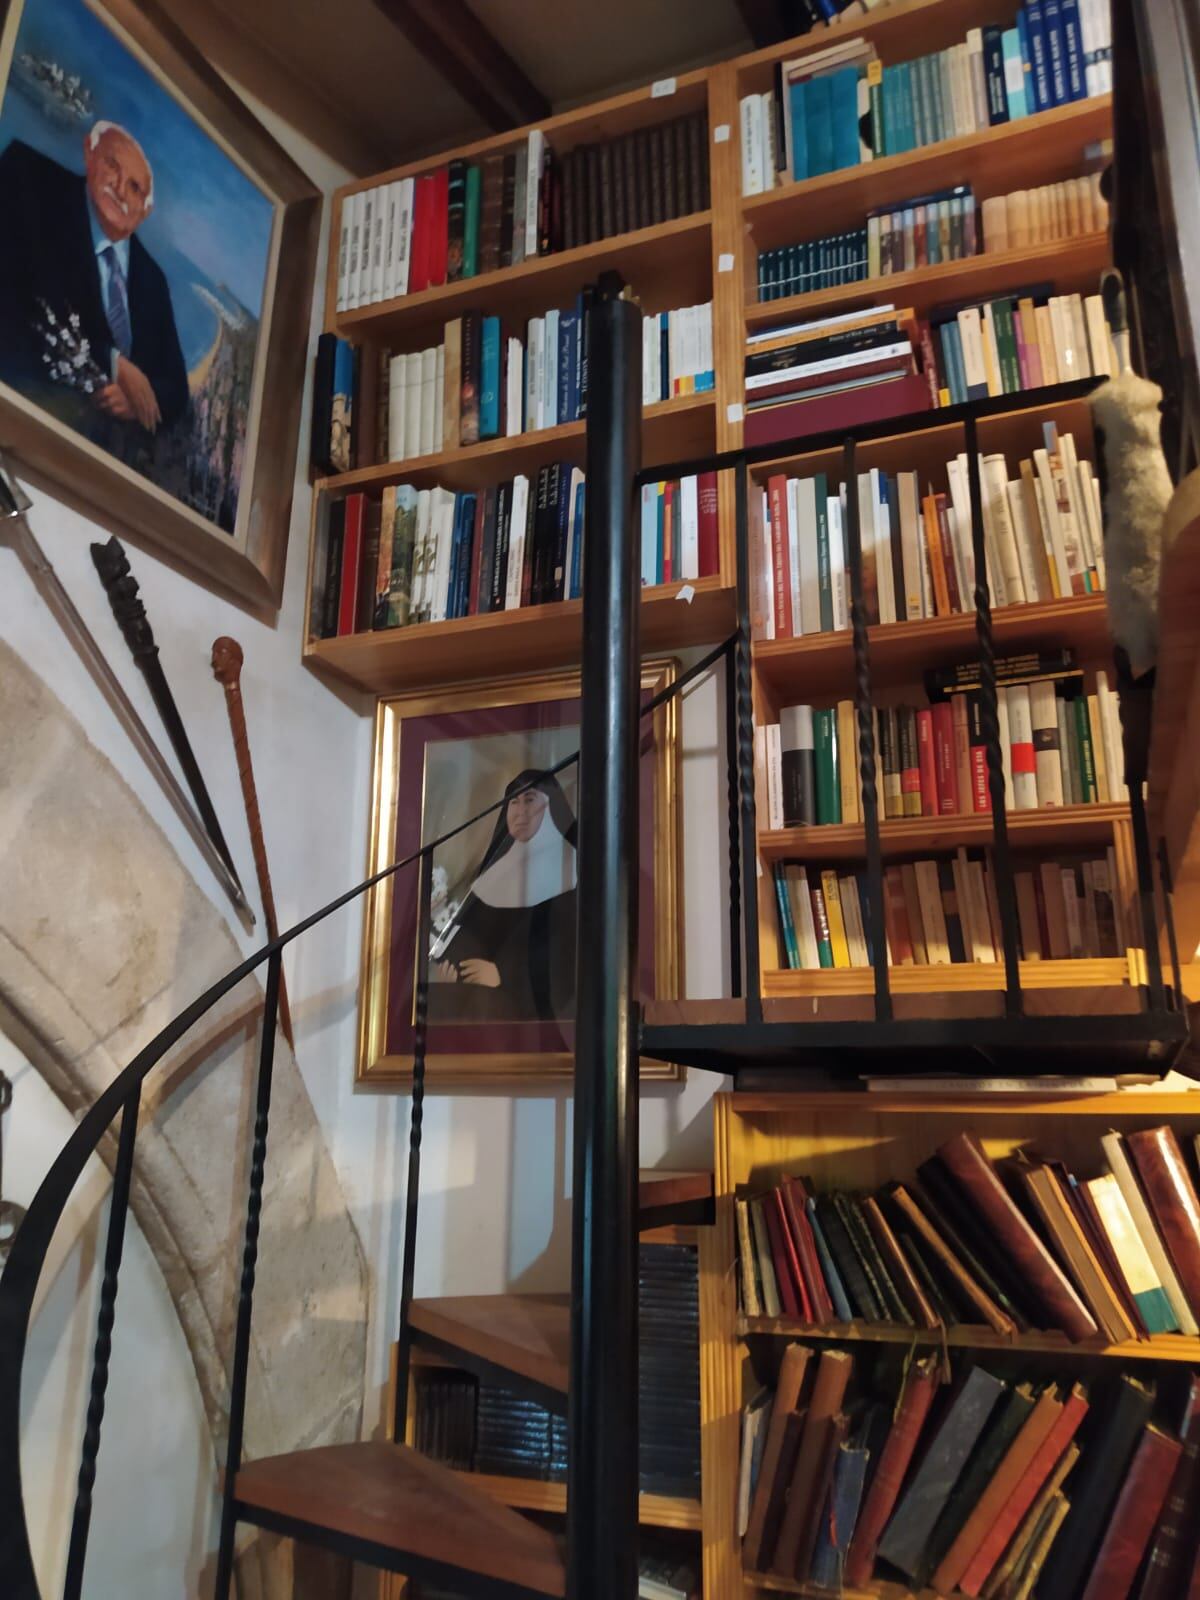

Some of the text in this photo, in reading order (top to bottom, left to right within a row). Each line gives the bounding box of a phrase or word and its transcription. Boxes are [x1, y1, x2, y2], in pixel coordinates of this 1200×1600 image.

[975, 751, 987, 808] LOS JEFES DE ETA
